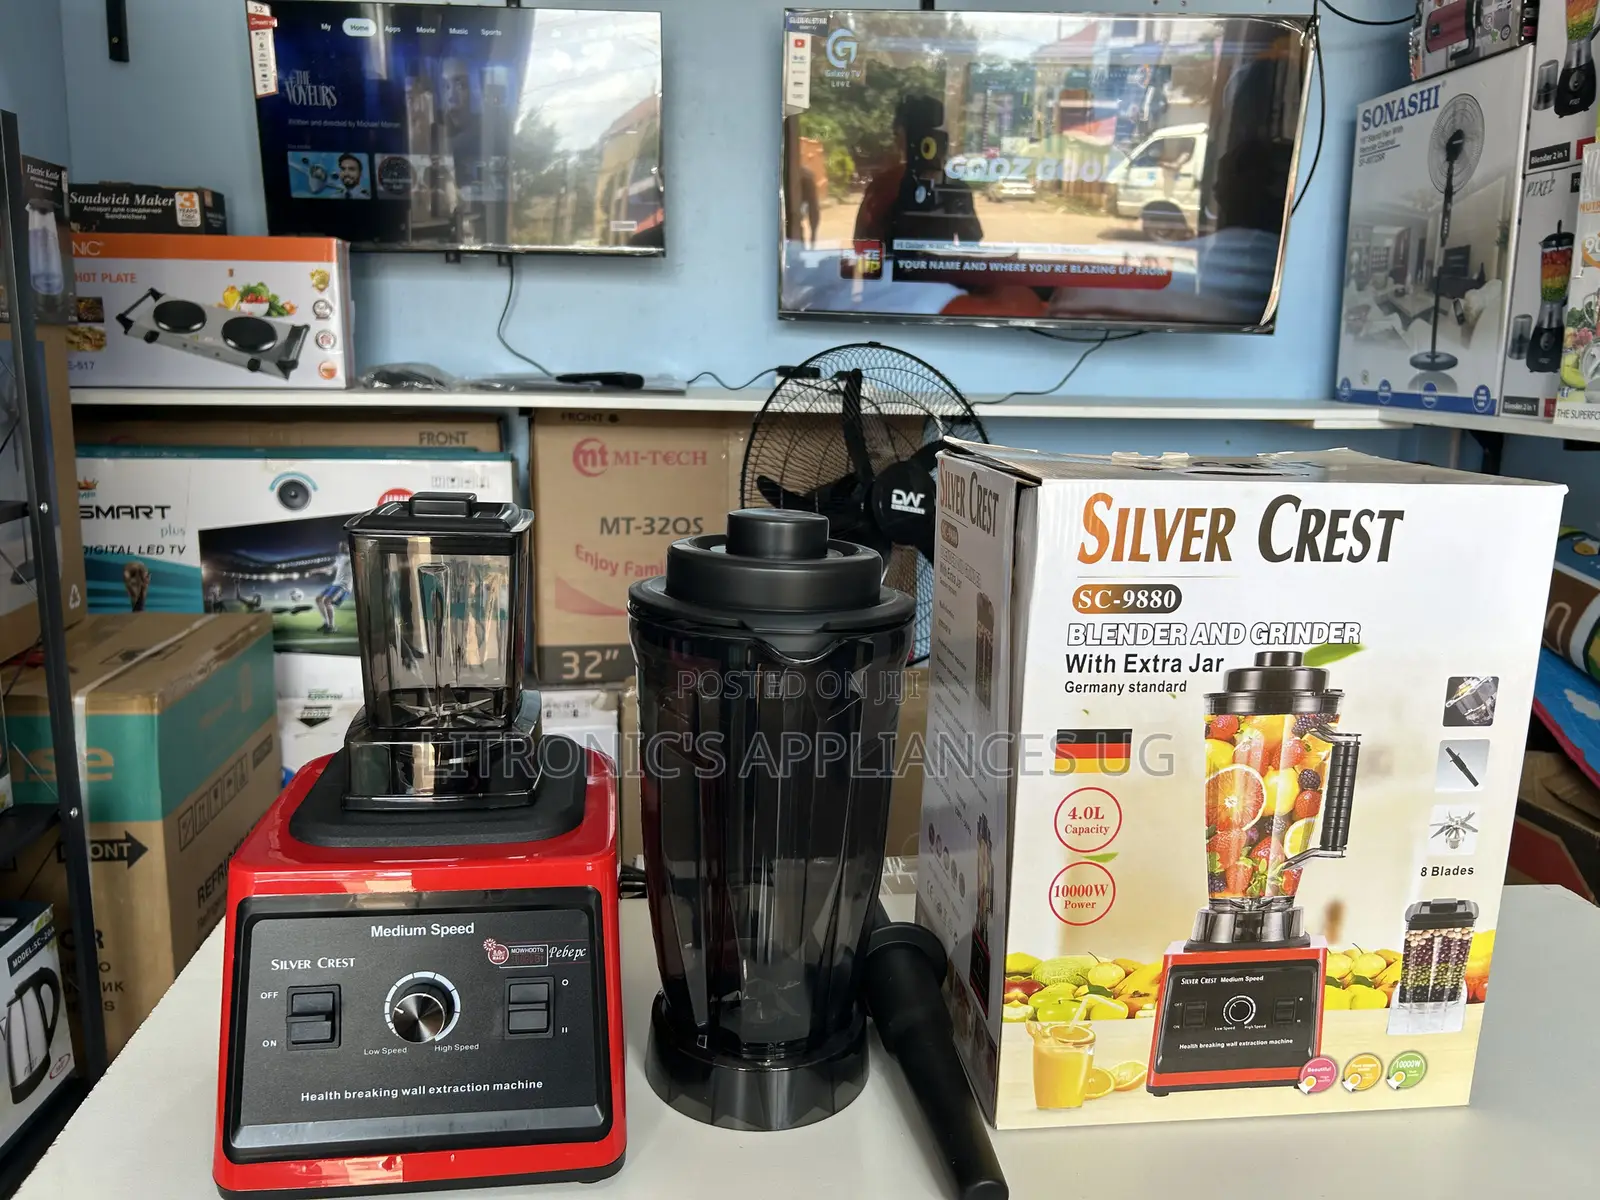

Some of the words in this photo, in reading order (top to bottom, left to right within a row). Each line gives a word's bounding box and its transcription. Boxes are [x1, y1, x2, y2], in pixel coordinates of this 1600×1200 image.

[321, 23, 331, 32] My
[350, 24, 369, 33] Home
[384, 25, 401, 35] Apps
[416, 26, 436, 34] Movie
[449, 27, 468, 35] Music
[481, 28, 502, 37] Sports
[292, 69, 311, 86] THE
[1362, 84, 1441, 133] SONASHI
[1531, 154, 1553, 165] Blender
[70, 192, 130, 205] Sandwich
[134, 193, 174, 206] Maker
[179, 191, 196, 208] 3
[898, 259, 927, 270] YOUR
[929, 260, 960, 271] NAME
[963, 261, 987, 271] AND
[989, 262, 1027, 273] WHERE
[1028, 263, 1068, 274] YOU'RE
[1070, 264, 1117, 275] BLAZING
[1119, 266, 1134, 275] UP
[1136, 267, 1168, 276] FROM
[75, 272, 97, 284] HOT
[101, 272, 137, 284] PLATE
[560, 412, 604, 423] FRONT
[1557, 408, 1569, 419] THE
[419, 431, 469, 446] FRONT
[940, 459, 967, 519] SILVER
[969, 471, 1000, 538] CREST
[79, 504, 171, 520] SMART
[161, 523, 186, 539] plus
[600, 516, 704, 537] MT-32QS
[1077, 492, 1237, 565] SILVER
[1258, 493, 1406, 565] CREST
[138, 545, 165, 556] LED
[168, 545, 187, 556] TV
[575, 544, 619, 578] Enjoy
[624, 560, 667, 579] Fami
[1077, 588, 1177, 610] SC-9880
[1067, 622, 1188, 647] BLENDER
[1190, 622, 1248, 646] AND
[1250, 621, 1362, 647] GRINDER
[1065, 653, 1120, 674] With
[1123, 653, 1183, 674] Extra
[1189, 653, 1225, 674] Jar
[1064, 680, 1125, 696] Germany
[1128, 680, 1188, 693] standard
[1067, 806, 1106, 821] 4.0L
[1064, 824, 1111, 837] Capacity
[1420, 866, 1428, 878] 8
[1431, 865, 1475, 877] Blades
[1053, 884, 1109, 898] 10000W
[1064, 899, 1097, 910] Power
[370, 925, 427, 938] Medium
[430, 922, 475, 938] Speed
[271, 958, 312, 971] SILVER
[317, 956, 356, 969] CREST
[1180, 977, 1199, 986] SILVER
[1200, 975, 1218, 985] CREST
[1220, 976, 1244, 984] Medium
[1245, 975, 1264, 983] Speed
[260, 991, 279, 1000] OFF
[262, 1039, 277, 1048] ON
[434, 1044, 453, 1054] High
[454, 1043, 480, 1053] Speed
[1199, 1041, 1225, 1050] breaking
[1226, 1040, 1238, 1048] wall
[1239, 1039, 1268, 1047] extraction
[1268, 1038, 1294, 1046] machine
[363, 1048, 380, 1056] Low
[381, 1046, 408, 1056] Speed
[1307, 1066, 1332, 1074] Beautiful
[1396, 1060, 1421, 1069] 10000W
[300, 1091, 341, 1102] Health
[344, 1087, 399, 1100] breaking
[401, 1085, 426, 1097] wall
[428, 1081, 491, 1095] extraction
[493, 1079, 544, 1091] machine
